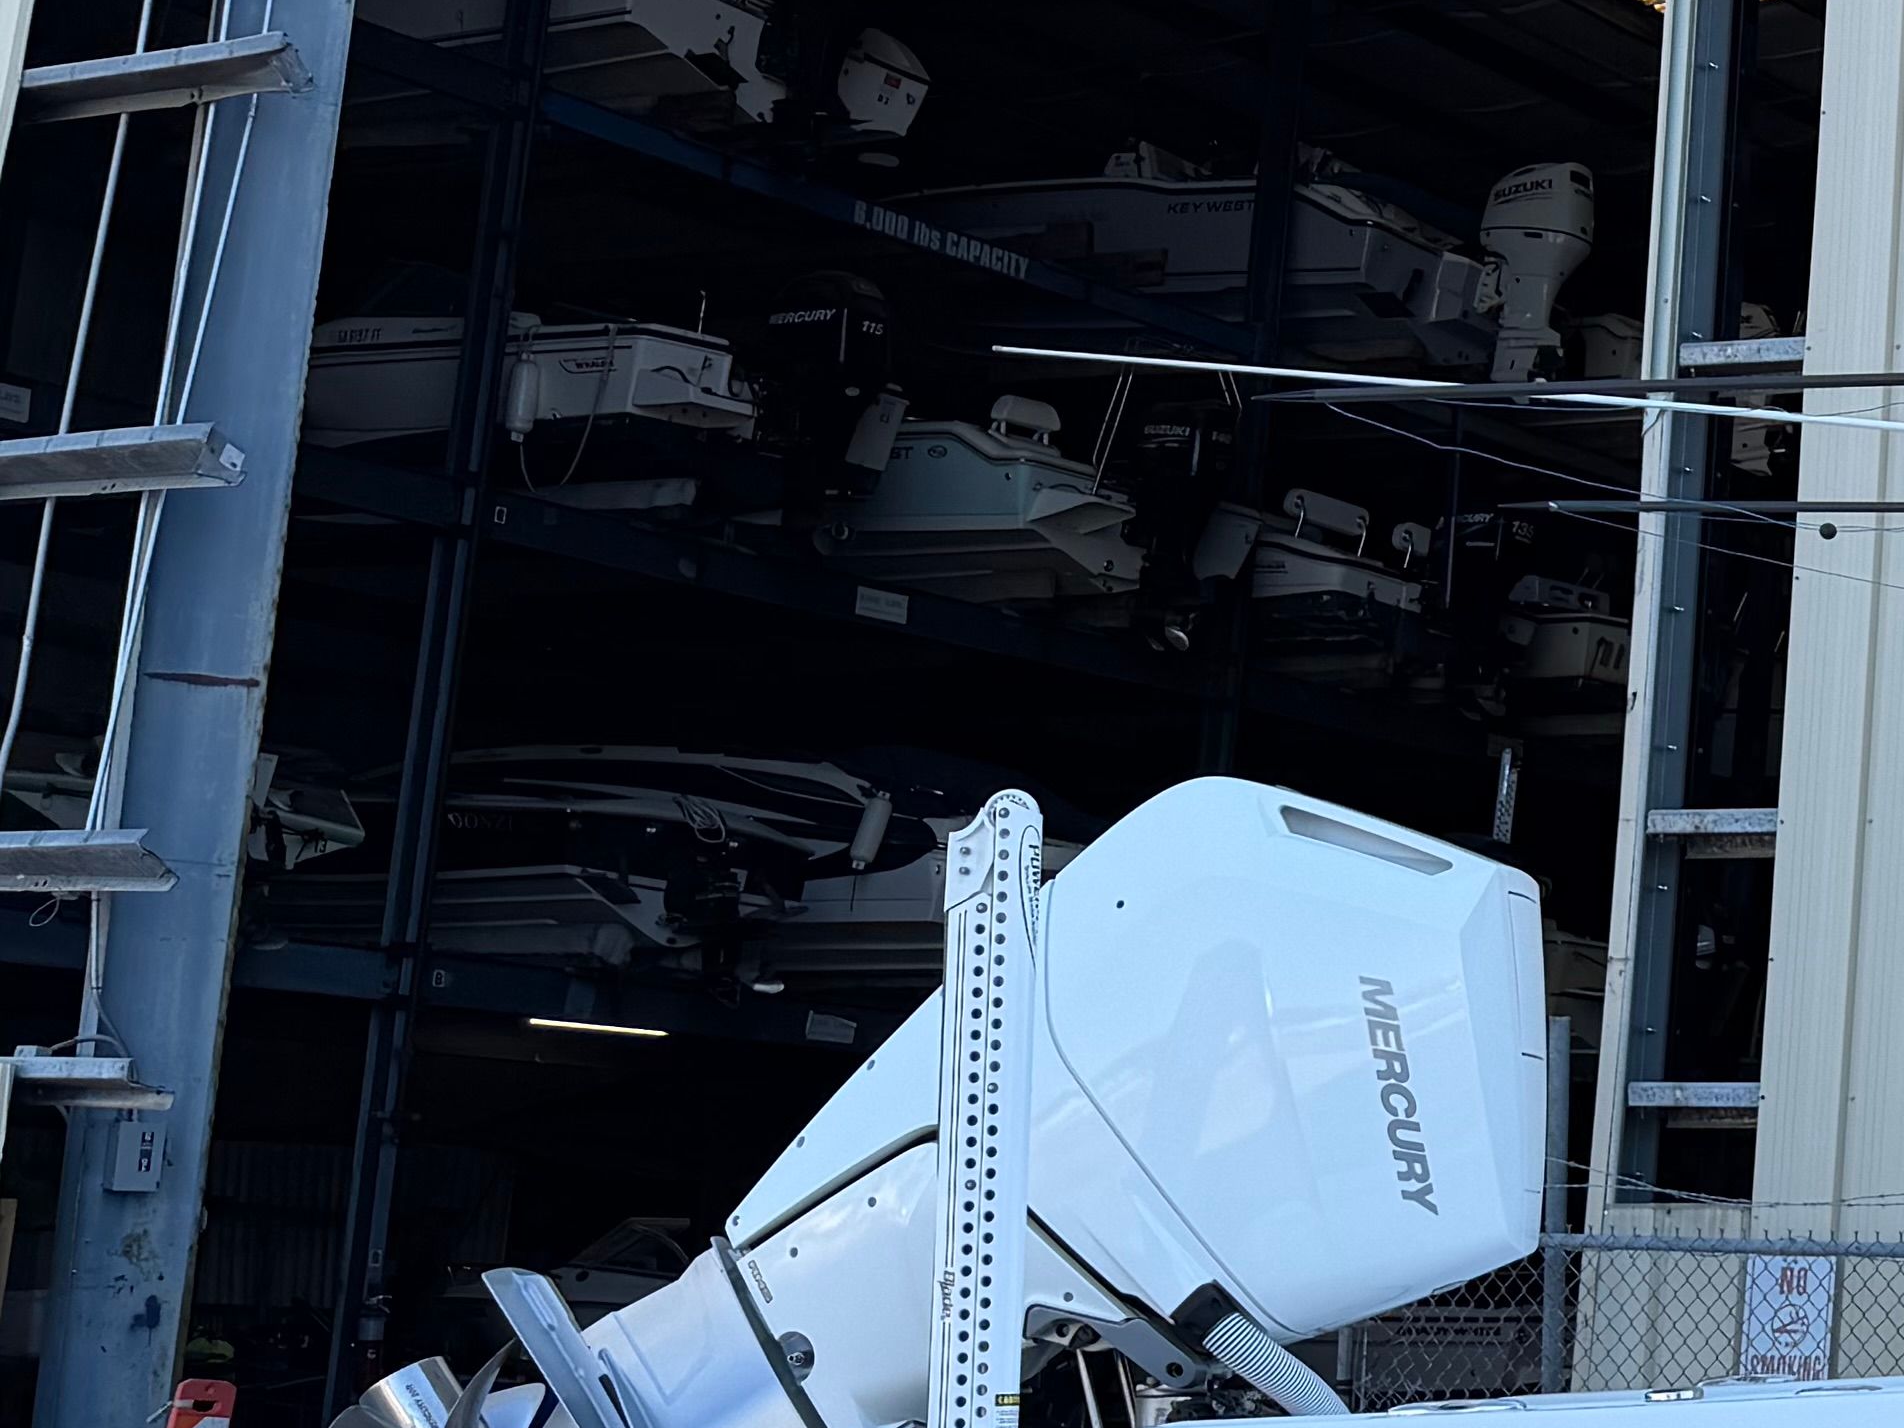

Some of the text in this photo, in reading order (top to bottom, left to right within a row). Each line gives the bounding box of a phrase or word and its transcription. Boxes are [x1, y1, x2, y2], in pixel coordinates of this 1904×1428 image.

[1494, 179, 1552, 202] SUZUKI
[1167, 202, 1203, 214] KEY
[913, 220, 941, 251] lbs
[945, 231, 1030, 280] CAPACITY
[768, 309, 884, 335] MERCURY 115
[1358, 975, 1439, 1216] MERCURY
[1779, 1266, 1808, 1296] NO
